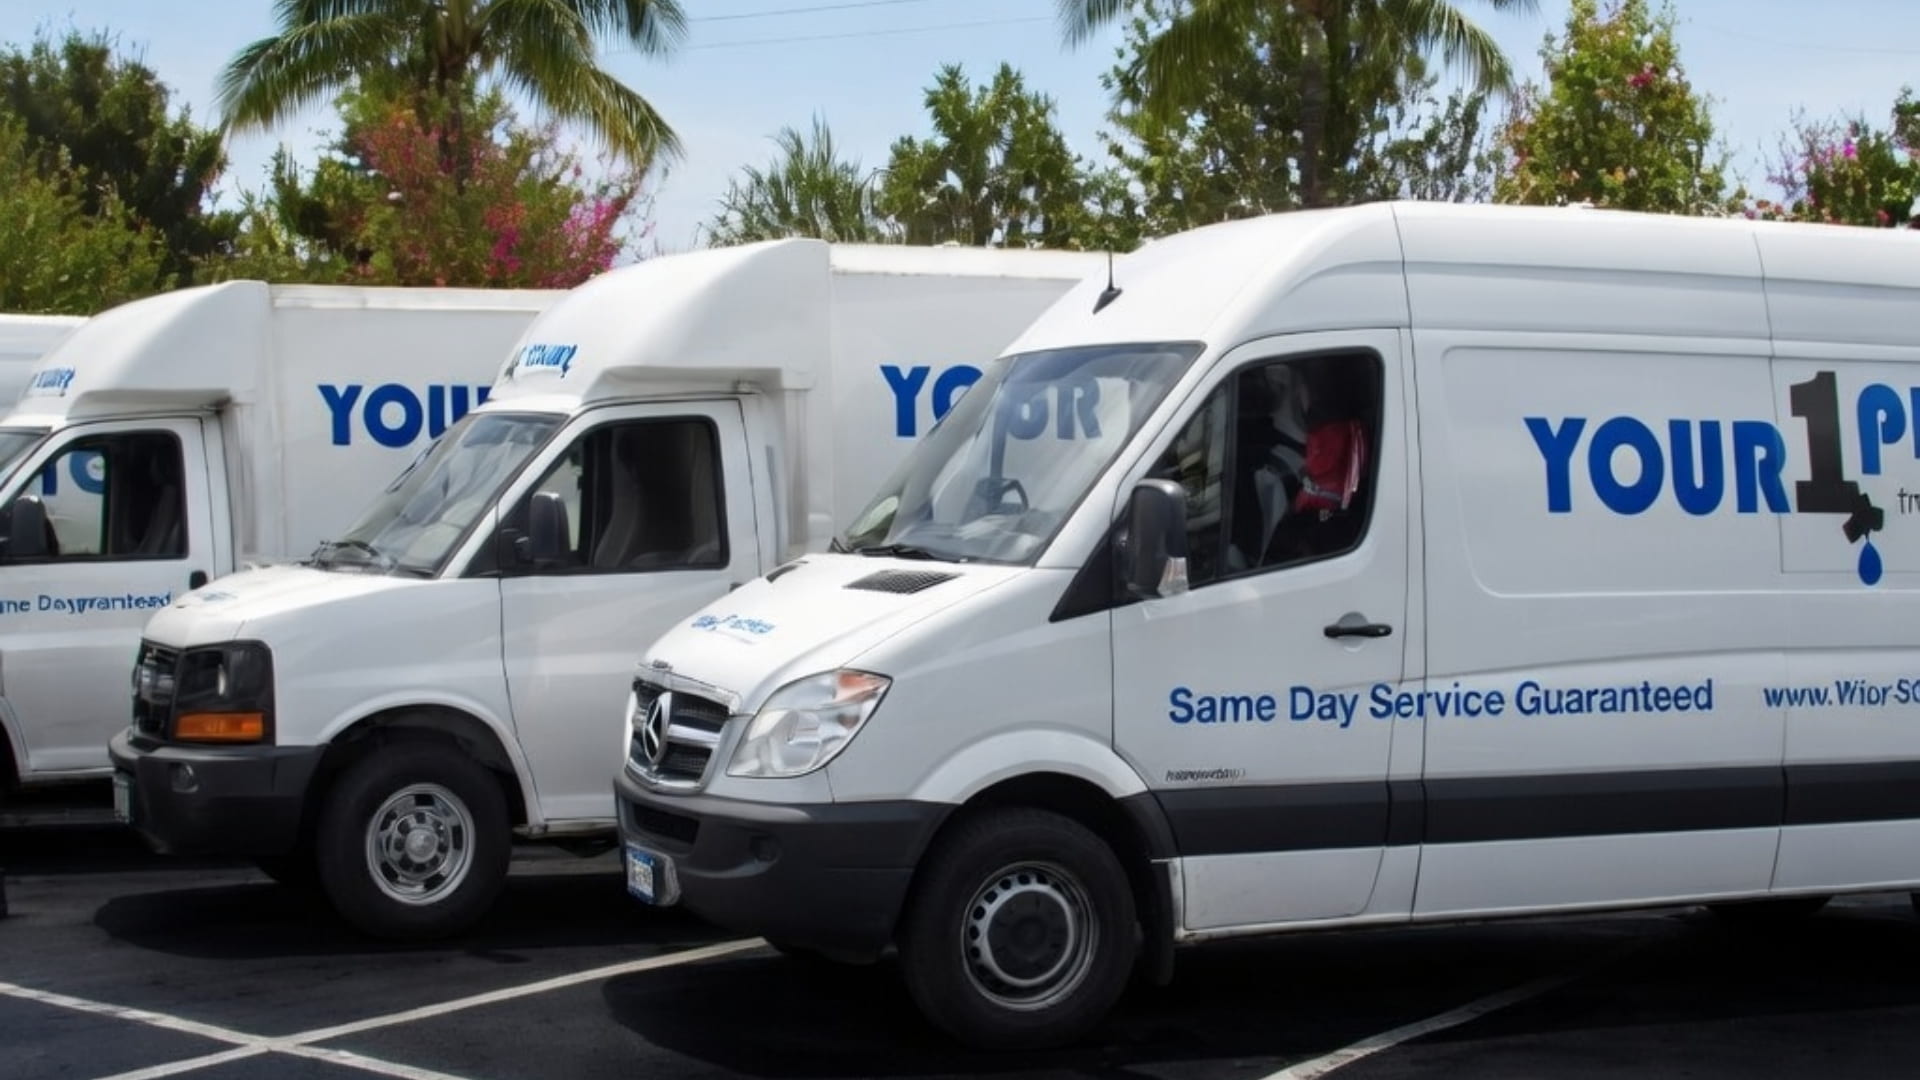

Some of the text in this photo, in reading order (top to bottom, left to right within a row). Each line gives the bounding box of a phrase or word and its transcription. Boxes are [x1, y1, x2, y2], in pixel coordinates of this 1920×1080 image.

[317, 383, 492, 448] YOU
[1523, 416, 1791, 516] YOUR
[1169, 678, 1713, 728] Same Day Service Guaranteed
